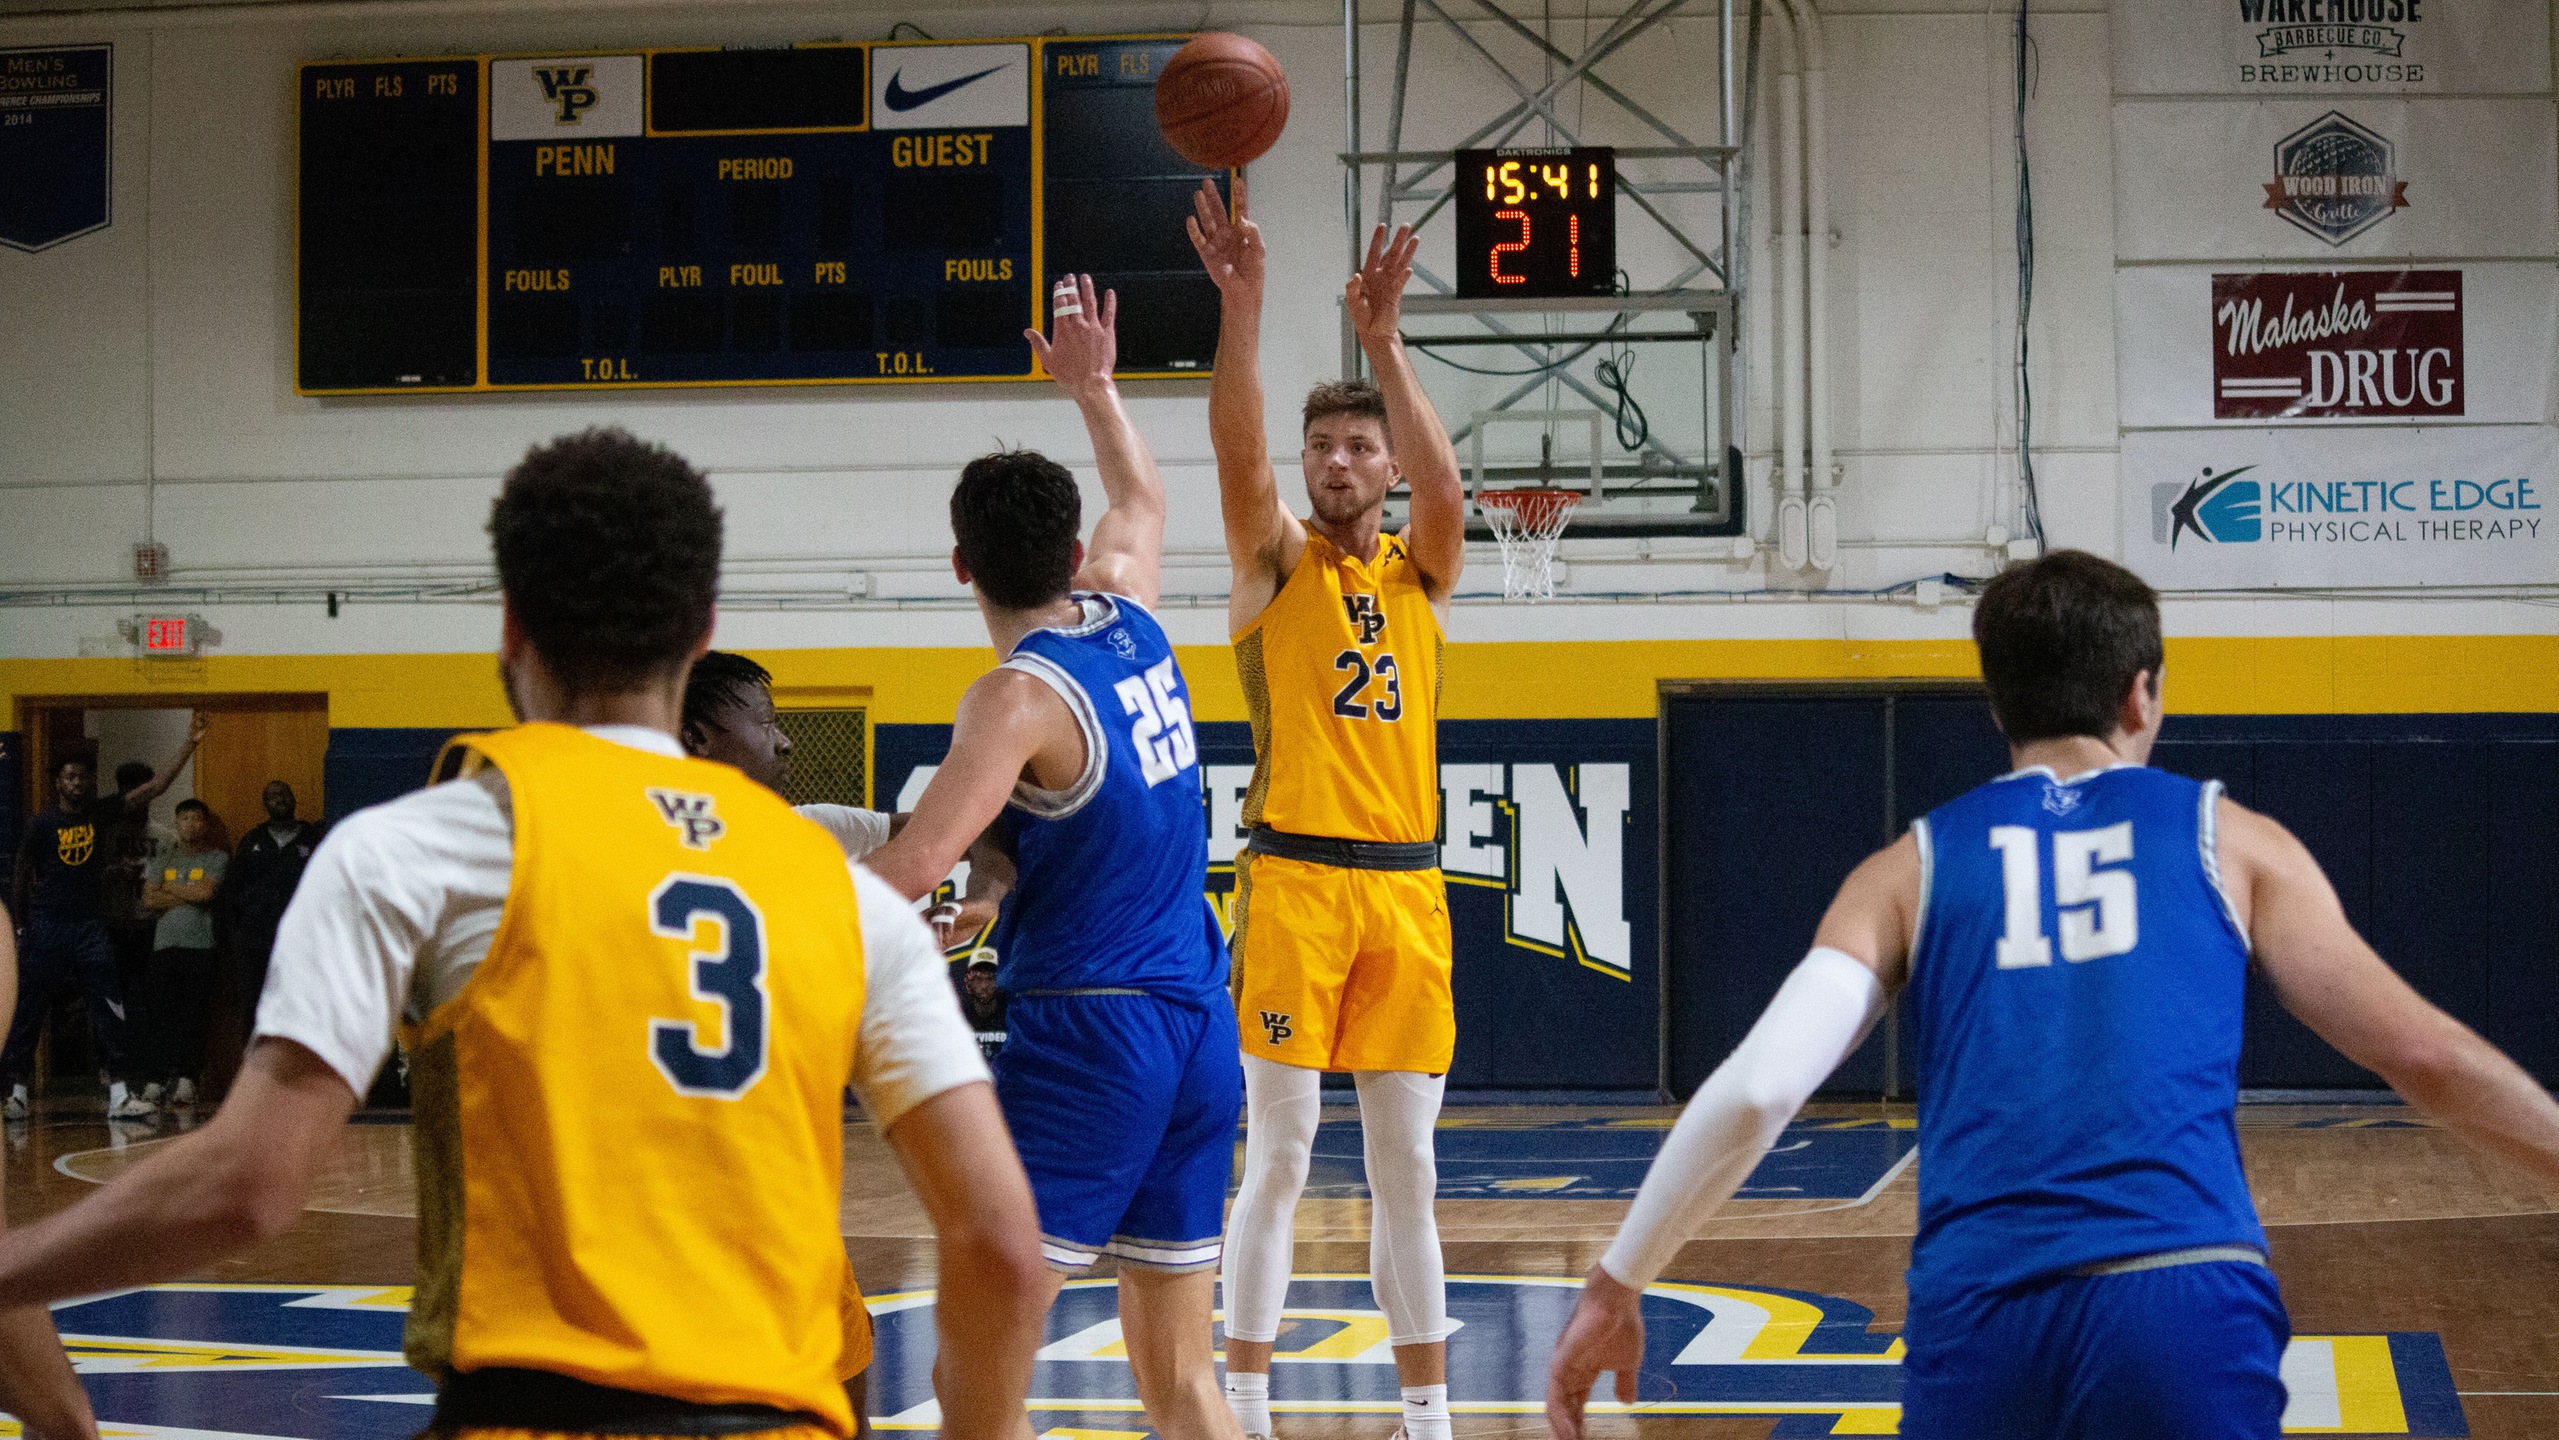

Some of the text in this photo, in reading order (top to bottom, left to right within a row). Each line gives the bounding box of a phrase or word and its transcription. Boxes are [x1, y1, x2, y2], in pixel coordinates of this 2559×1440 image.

[2275, 28, 2387, 47] BARBECUE CO.
[1057, 54, 1099, 76] PLYR
[1120, 53, 1149, 74] FLS
[2240, 64, 2424, 83] BREWHOUSE
[0, 74, 78, 90] BOWLING
[316, 78, 355, 99] PLYR
[375, 77, 402, 97] FLS
[428, 74, 457, 95] PTS
[4, 114, 33, 126] 2014
[536, 145, 615, 176] PENN
[892, 134, 993, 167] GUEST
[1497, 148, 1571, 157] DAKTRONICS
[718, 158, 793, 180] PERIOD
[1487, 161, 1598, 204] 15:41
[2283, 176, 2387, 197] WOOD IRON
[1490, 210, 1579, 284] 21
[505, 270, 570, 291] FOULS
[659, 266, 701, 288] PLYR
[730, 264, 783, 286] FOUL
[815, 262, 846, 284] PTS
[945, 259, 1013, 281] FOULS
[2218, 282, 2371, 357] Mahaska
[582, 358, 638, 380] T.O.L.
[877, 352, 934, 375] T.O.L.
[2306, 347, 2455, 408] DRUG
[2271, 478, 2541, 514] KINETIC EDGE
[2271, 518, 2541, 543] PHYSICAL THERAPY
[148, 619, 186, 649] EXIT
[1332, 649, 1403, 723] 23
[1113, 655, 1197, 790] 25
[1989, 819, 2138, 970] 15
[648, 871, 769, 1100] 3
[975, 1031, 1007, 1043] VIDED
